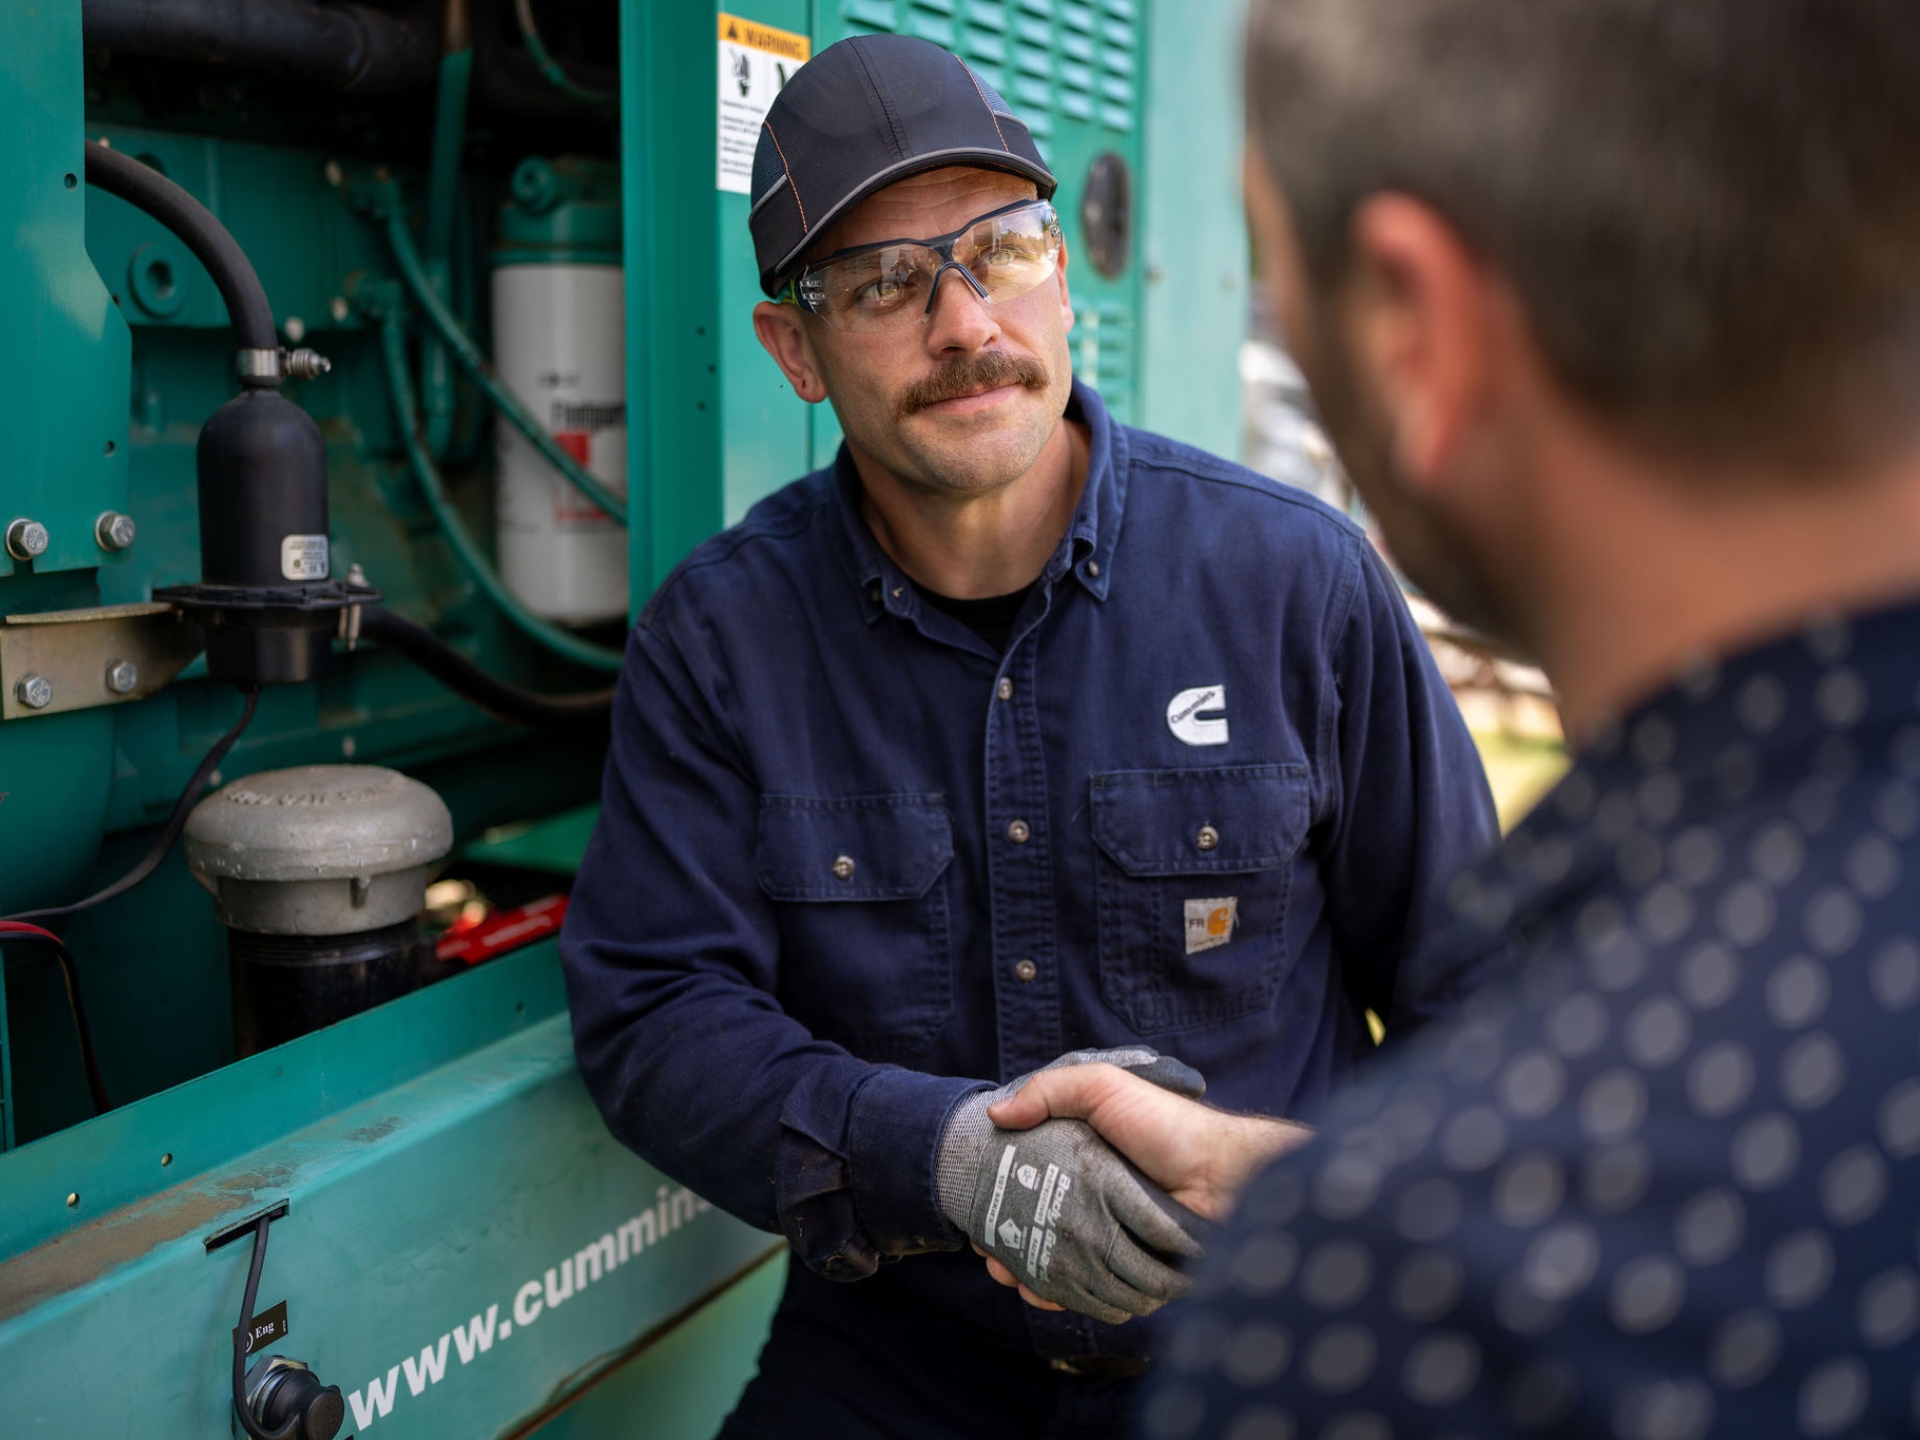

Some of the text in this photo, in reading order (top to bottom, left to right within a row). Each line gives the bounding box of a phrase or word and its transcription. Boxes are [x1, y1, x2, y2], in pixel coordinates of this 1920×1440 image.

[745, 28, 802, 57] WARNING
[1188, 918, 1204, 929] FR
[988, 1192, 1001, 1224] SERIES
[1047, 1173, 1072, 1228] Body
[255, 1322, 275, 1339] Eng
